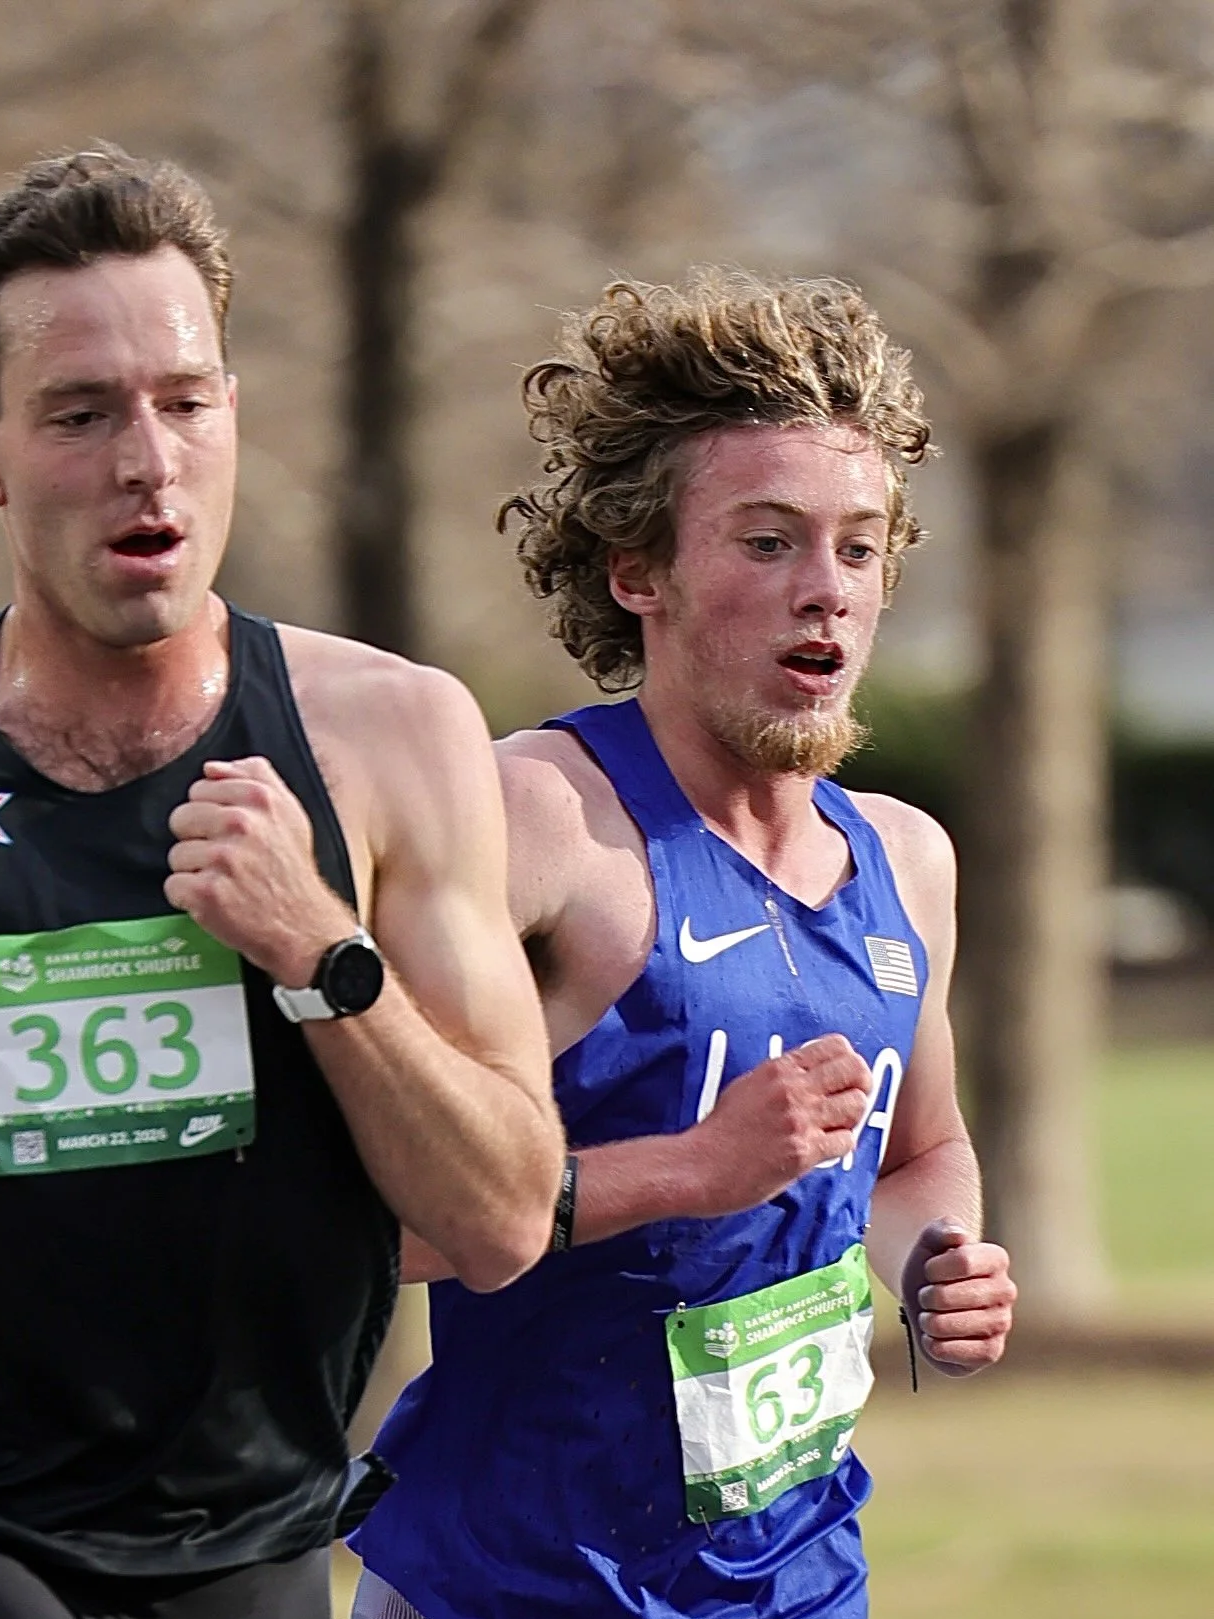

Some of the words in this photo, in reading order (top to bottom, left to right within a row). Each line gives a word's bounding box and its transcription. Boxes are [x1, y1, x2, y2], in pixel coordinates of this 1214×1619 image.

[44, 961, 131, 985] SHAMROCK
[134, 953, 202, 976] SHUFFLE
[101, 945, 159, 959] AMERICA
[8, 1000, 202, 1103] 363
[57, 1132, 109, 1151] MARCH
[744, 1312, 772, 1330] BANK
[771, 1307, 785, 1319] OF
[785, 1290, 828, 1313] AMERICA
[745, 1310, 807, 1346] SHAMROCK
[806, 1290, 855, 1320] SHUFFLE
[745, 1343, 825, 1444] 63
[796, 1447, 822, 1467] 2026
